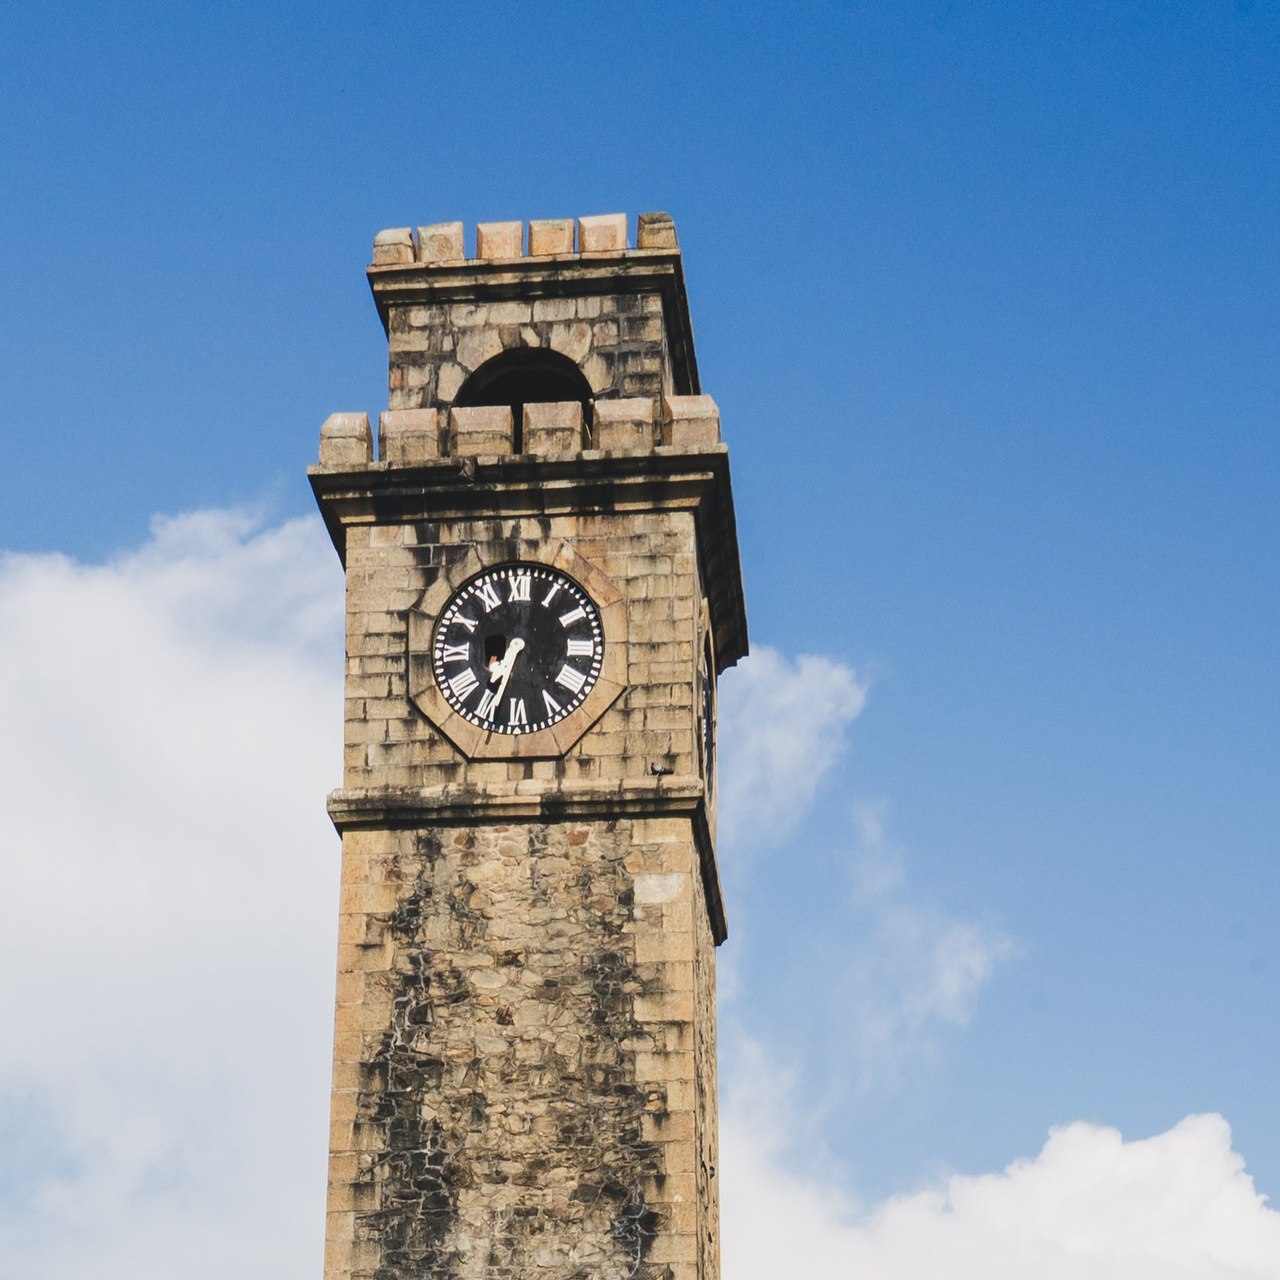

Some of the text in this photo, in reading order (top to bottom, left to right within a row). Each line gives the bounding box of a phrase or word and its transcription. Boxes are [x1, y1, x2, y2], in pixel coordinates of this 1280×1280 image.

[475, 583, 502, 613] XI
[508, 576, 531, 602] XII
[541, 583, 561, 608] I
[451, 612, 479, 633] X
[559, 606, 586, 628] II
[443, 642, 469, 662] IX
[567, 639, 594, 656] III
[448, 667, 479, 702] VIII
[508, 698, 527, 725] VI
[542, 690, 561, 717] V
